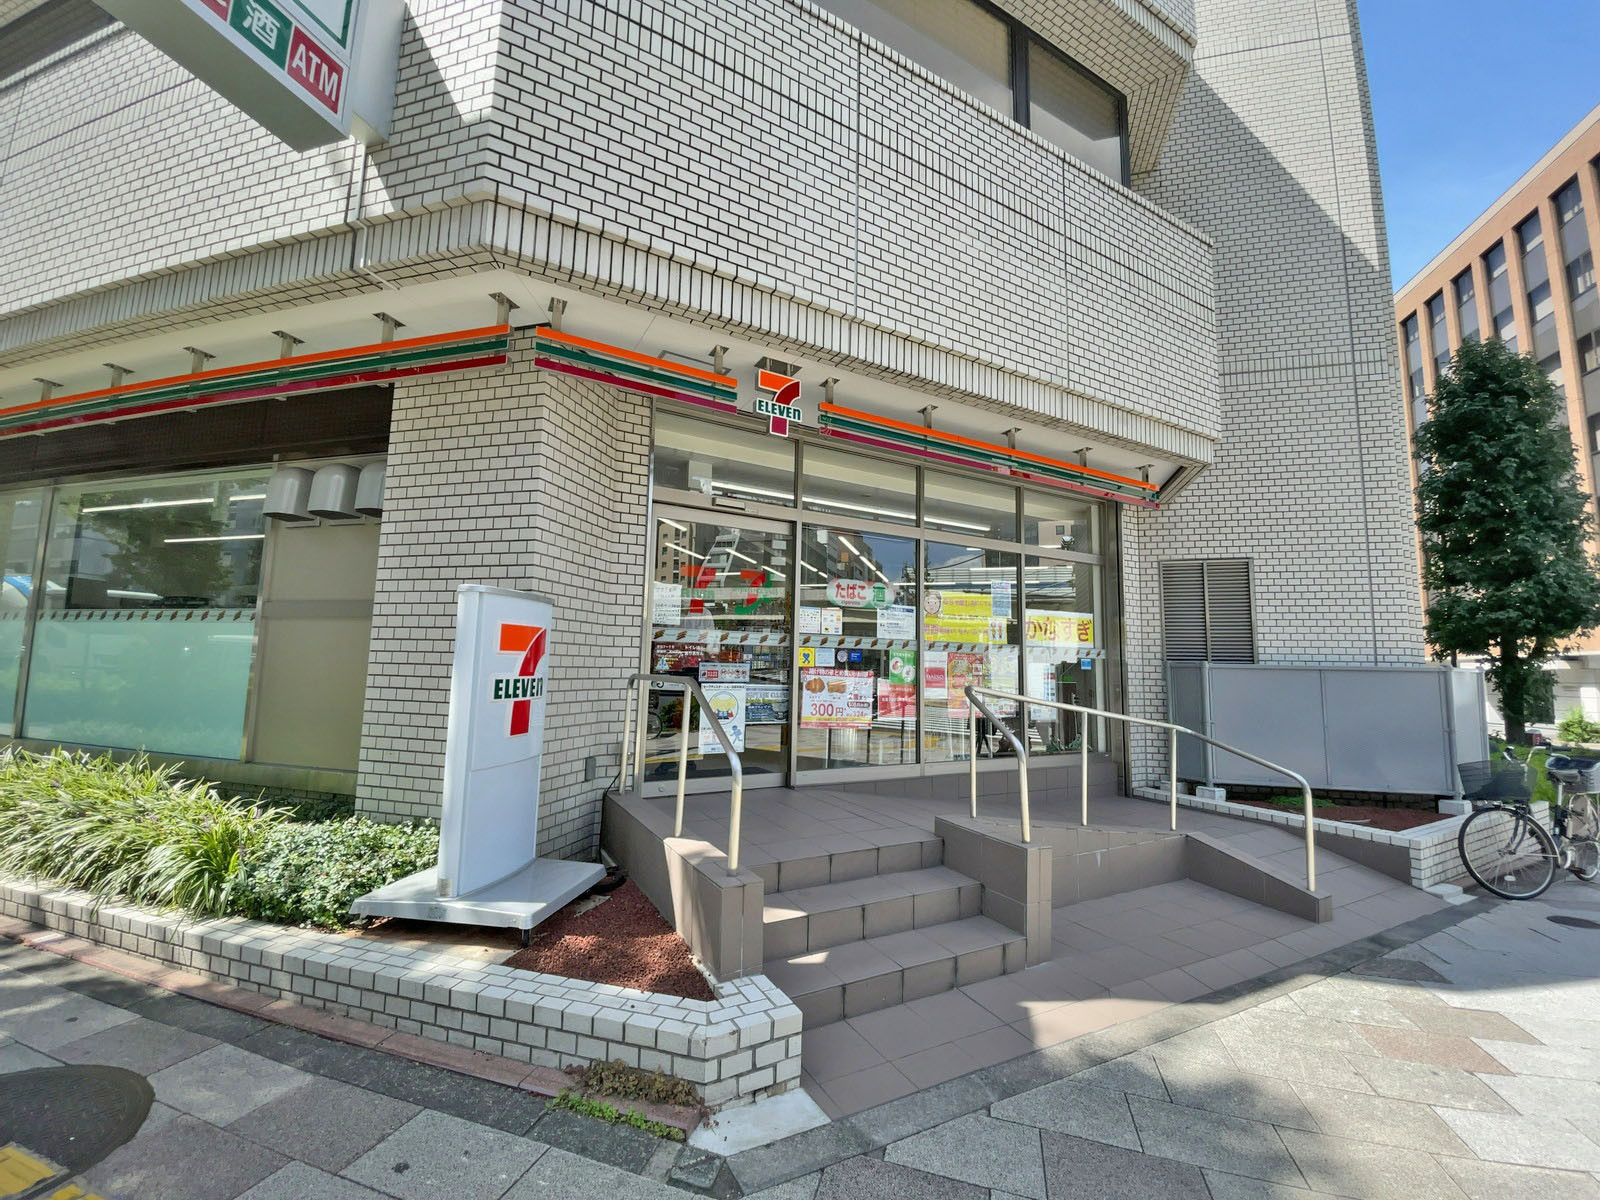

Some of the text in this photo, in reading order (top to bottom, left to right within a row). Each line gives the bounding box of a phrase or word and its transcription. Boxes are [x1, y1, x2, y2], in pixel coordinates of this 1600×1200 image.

[242, 0, 281, 50] 酒
[292, 43, 340, 102] ATM
[758, 369, 801, 436] 7
[835, 582, 867, 600] たばこ
[872, 586, 886, 602] 酒
[499, 623, 548, 736] 7
